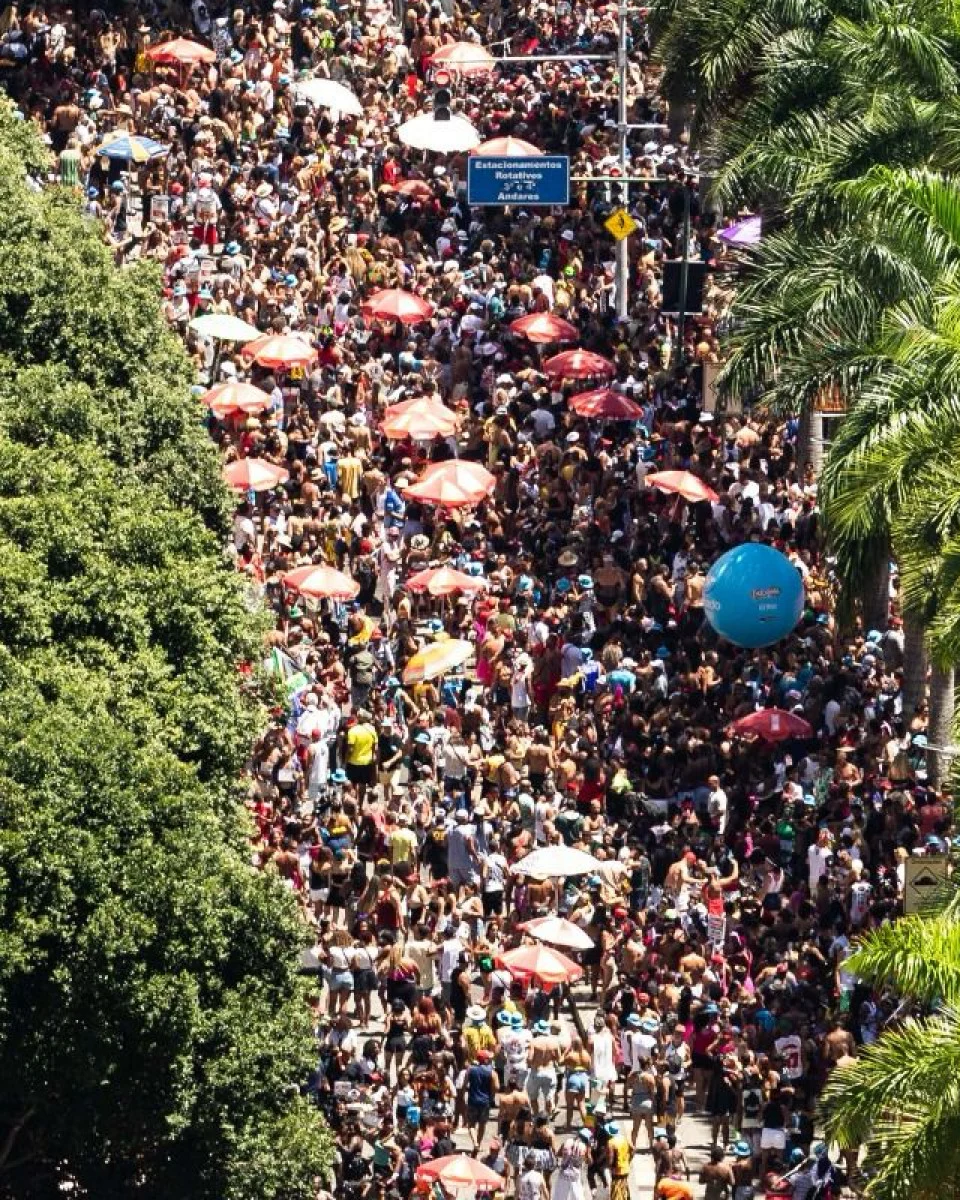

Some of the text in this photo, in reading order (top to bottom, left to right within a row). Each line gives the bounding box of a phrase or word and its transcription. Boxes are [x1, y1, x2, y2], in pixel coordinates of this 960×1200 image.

[474, 161, 562, 169] Estacionamentos
[494, 171, 543, 179] Rotativos
[497, 192, 540, 201] Andares
